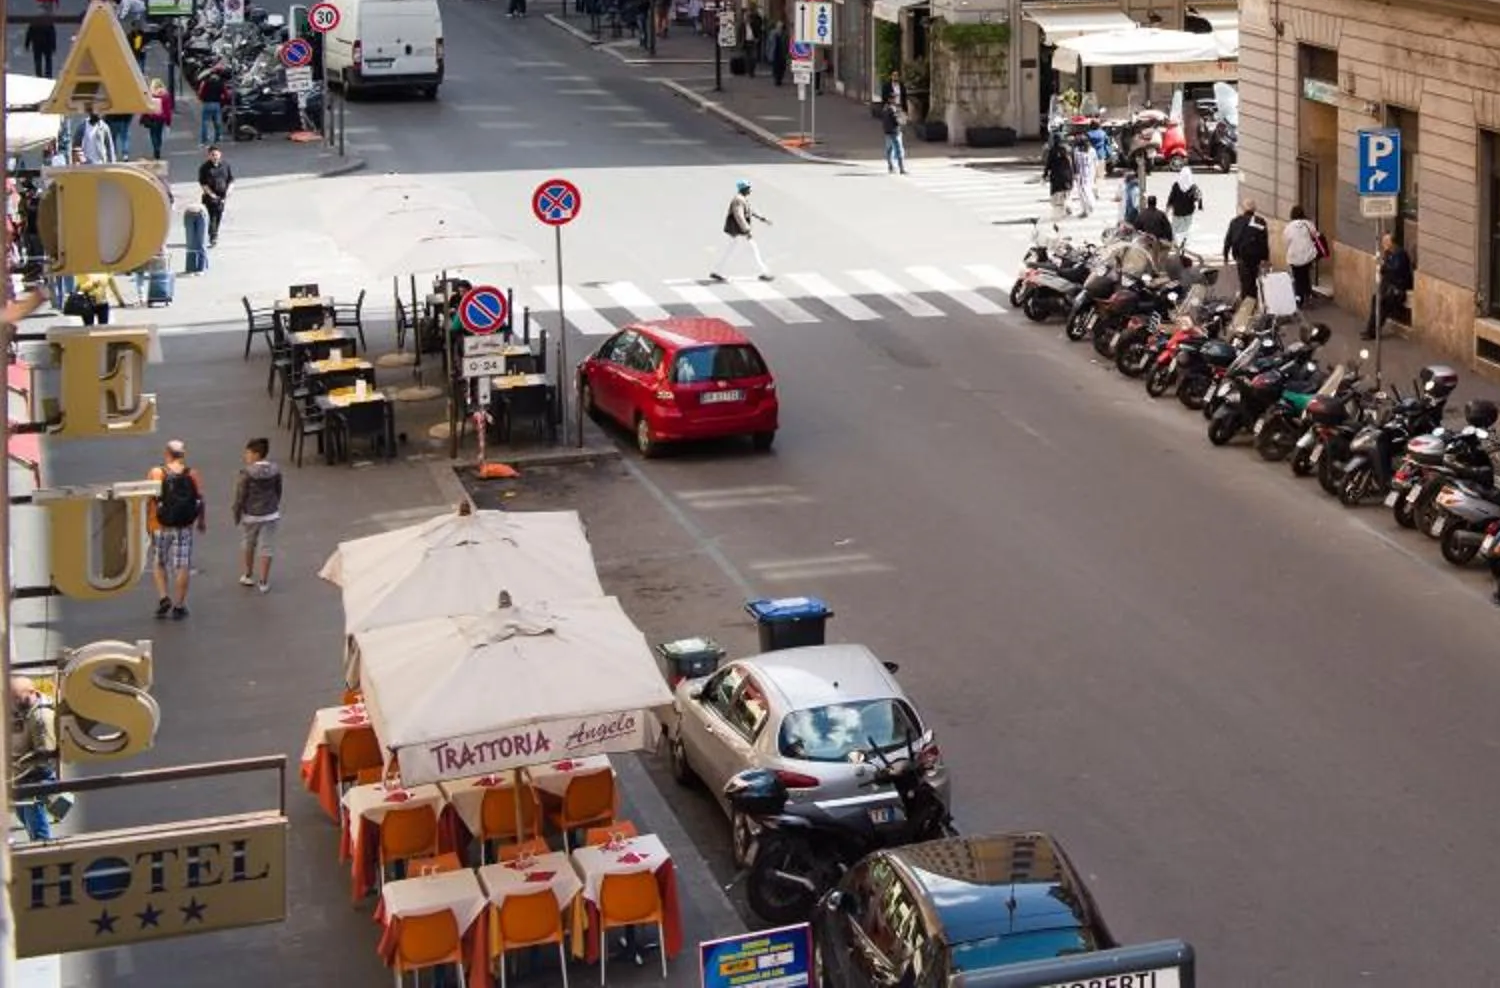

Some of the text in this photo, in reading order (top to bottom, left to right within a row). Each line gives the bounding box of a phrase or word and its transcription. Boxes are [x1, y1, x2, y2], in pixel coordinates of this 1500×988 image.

[318, 11, 334, 24] 30
[1368, 136, 1393, 167] P
[430, 713, 637, 775] TRATTORIA Angelo
[26, 839, 272, 909] HOTEL
